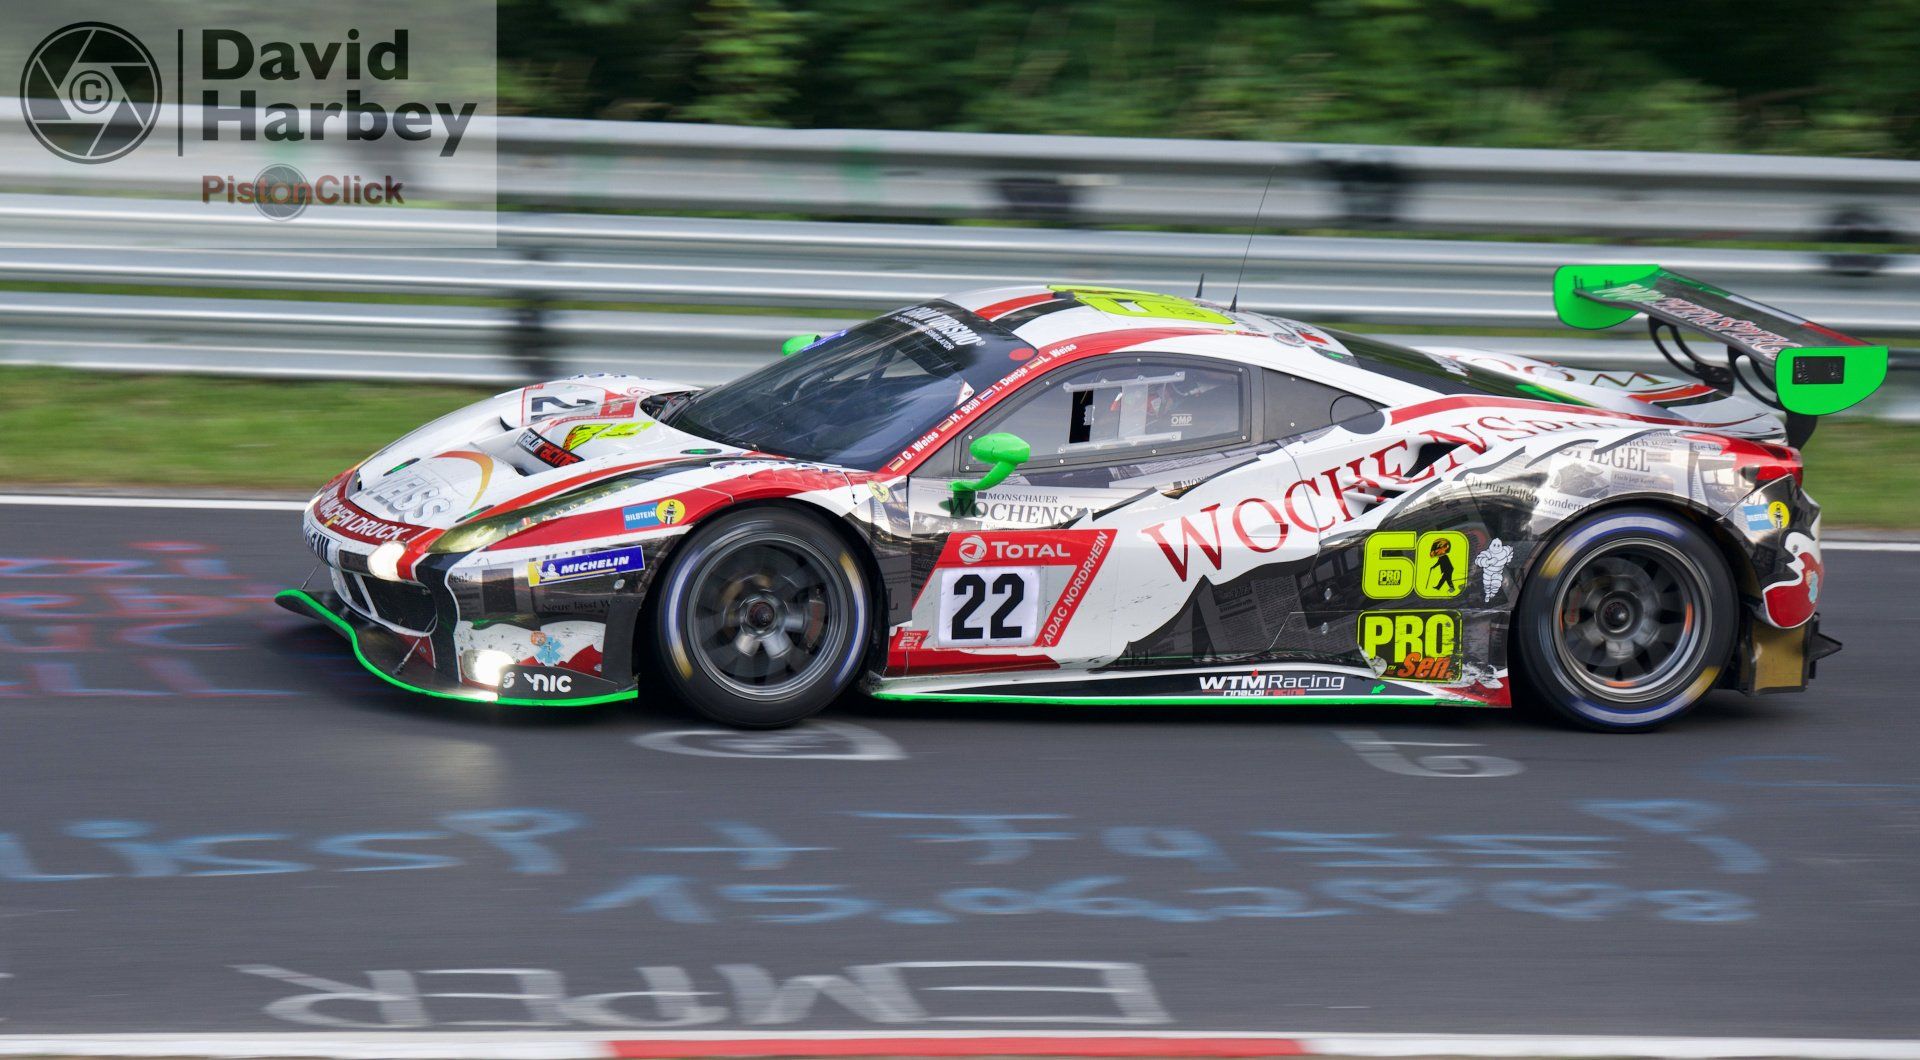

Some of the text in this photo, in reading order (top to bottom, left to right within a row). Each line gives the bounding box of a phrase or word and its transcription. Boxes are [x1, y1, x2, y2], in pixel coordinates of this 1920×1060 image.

[1049, 343, 1077, 359] Weiss
[1000, 366, 1028, 388] Dontje
[960, 398, 980, 415] Still
[1171, 415, 1193, 425] OMP
[912, 431, 939, 451] Weiss
[988, 492, 1058, 504] MONSCHAUER
[625, 507, 657, 522] BILSTEIN
[346, 514, 411, 541] DRUCK
[991, 541, 1071, 558] TOTAL
[561, 555, 630, 575] MICHELIN
[1044, 531, 1109, 645] ADAC NORDRHEIN
[951, 573, 1025, 640] 22
[1364, 614, 1455, 662] PRO
